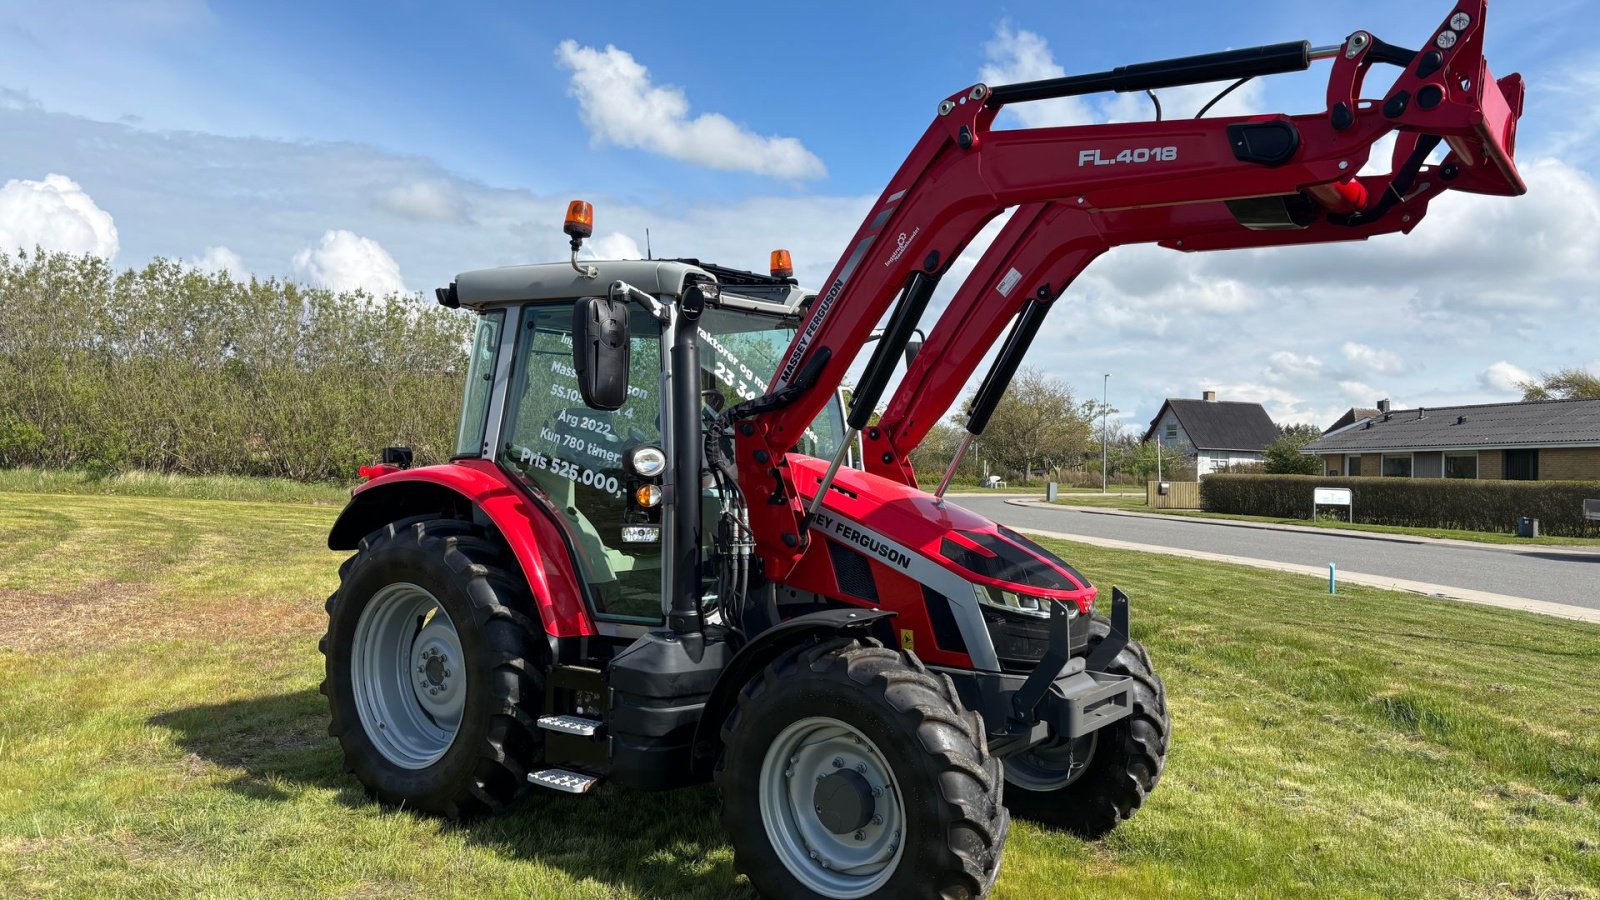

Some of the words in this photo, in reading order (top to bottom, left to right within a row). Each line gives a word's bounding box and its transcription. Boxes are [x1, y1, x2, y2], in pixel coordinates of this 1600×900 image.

[1079, 146, 1178, 167] FL.4018
[781, 337, 808, 383] MASSEY
[805, 278, 844, 338] FERGUSON
[550, 360, 579, 379] Mass
[714, 361, 736, 387] 23
[740, 363, 754, 381] og
[557, 407, 579, 428] Årg
[580, 416, 612, 435] 2022
[540, 427, 561, 444] Kun
[562, 434, 585, 451] 780
[519, 447, 548, 471] Pris
[812, 511, 834, 529] EY
[835, 521, 912, 569] FERGUSON
